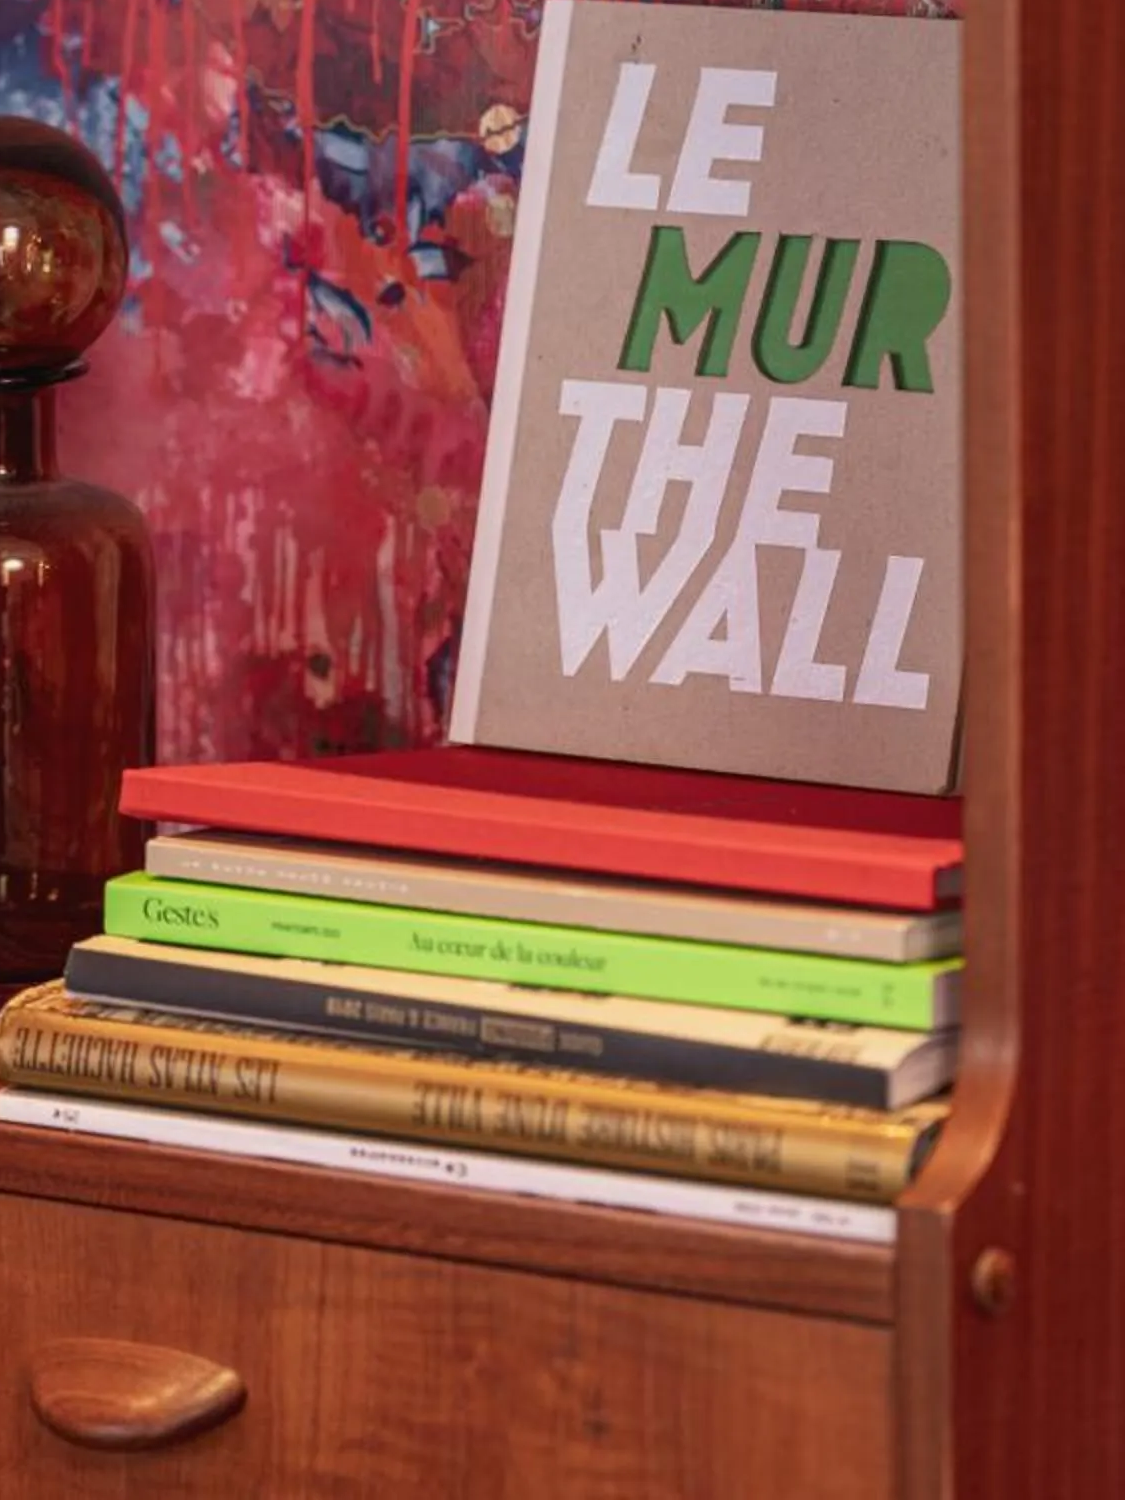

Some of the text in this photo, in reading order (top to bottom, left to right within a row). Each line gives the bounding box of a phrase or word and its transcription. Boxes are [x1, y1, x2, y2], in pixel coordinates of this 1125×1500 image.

[586, 62, 778, 217] LE
[617, 225, 952, 393] MUR
[557, 380, 847, 549] THE
[552, 526, 931, 710] WALL
[13, 1027, 281, 1104] LES ATLAS HACHETTE
